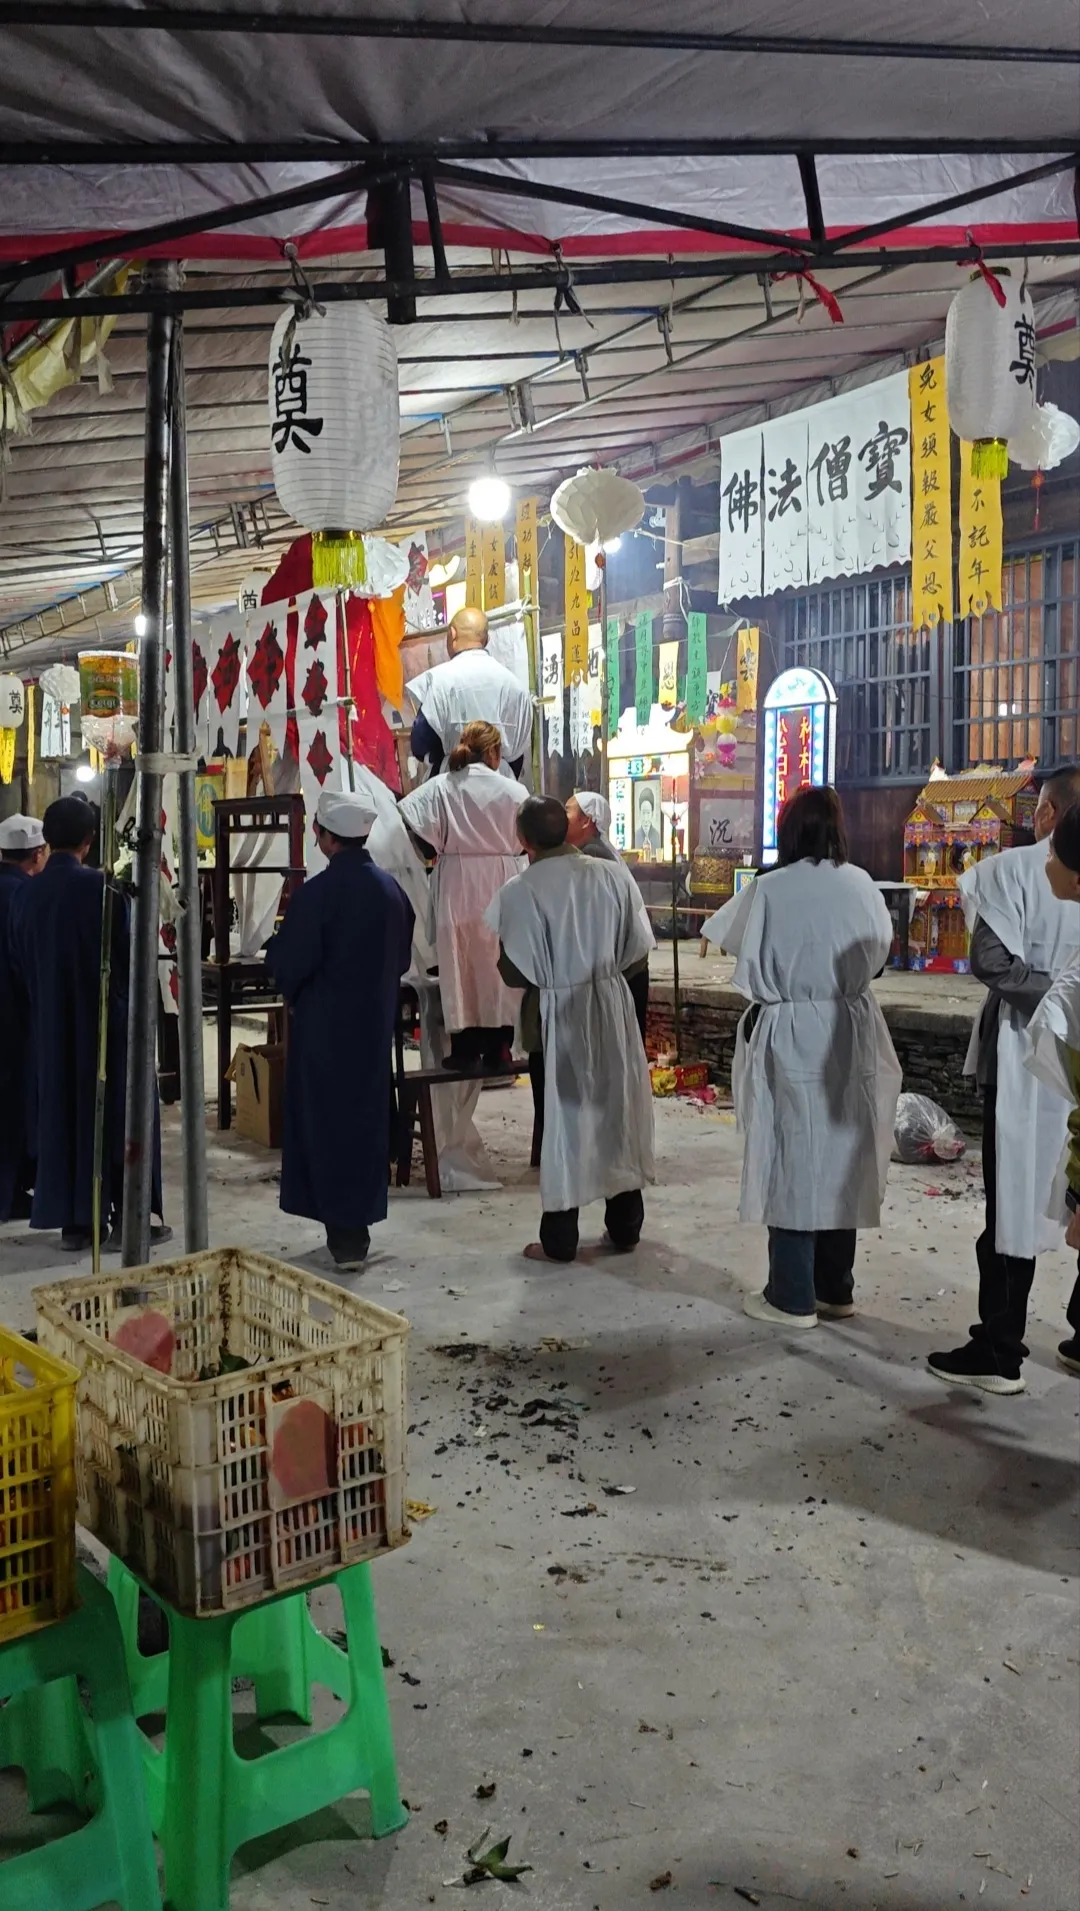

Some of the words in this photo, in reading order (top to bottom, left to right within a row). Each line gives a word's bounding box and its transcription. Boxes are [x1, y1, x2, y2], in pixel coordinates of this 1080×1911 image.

[271, 343, 324, 455] 奠
[722, 420, 909, 534] 佛法僧寶
